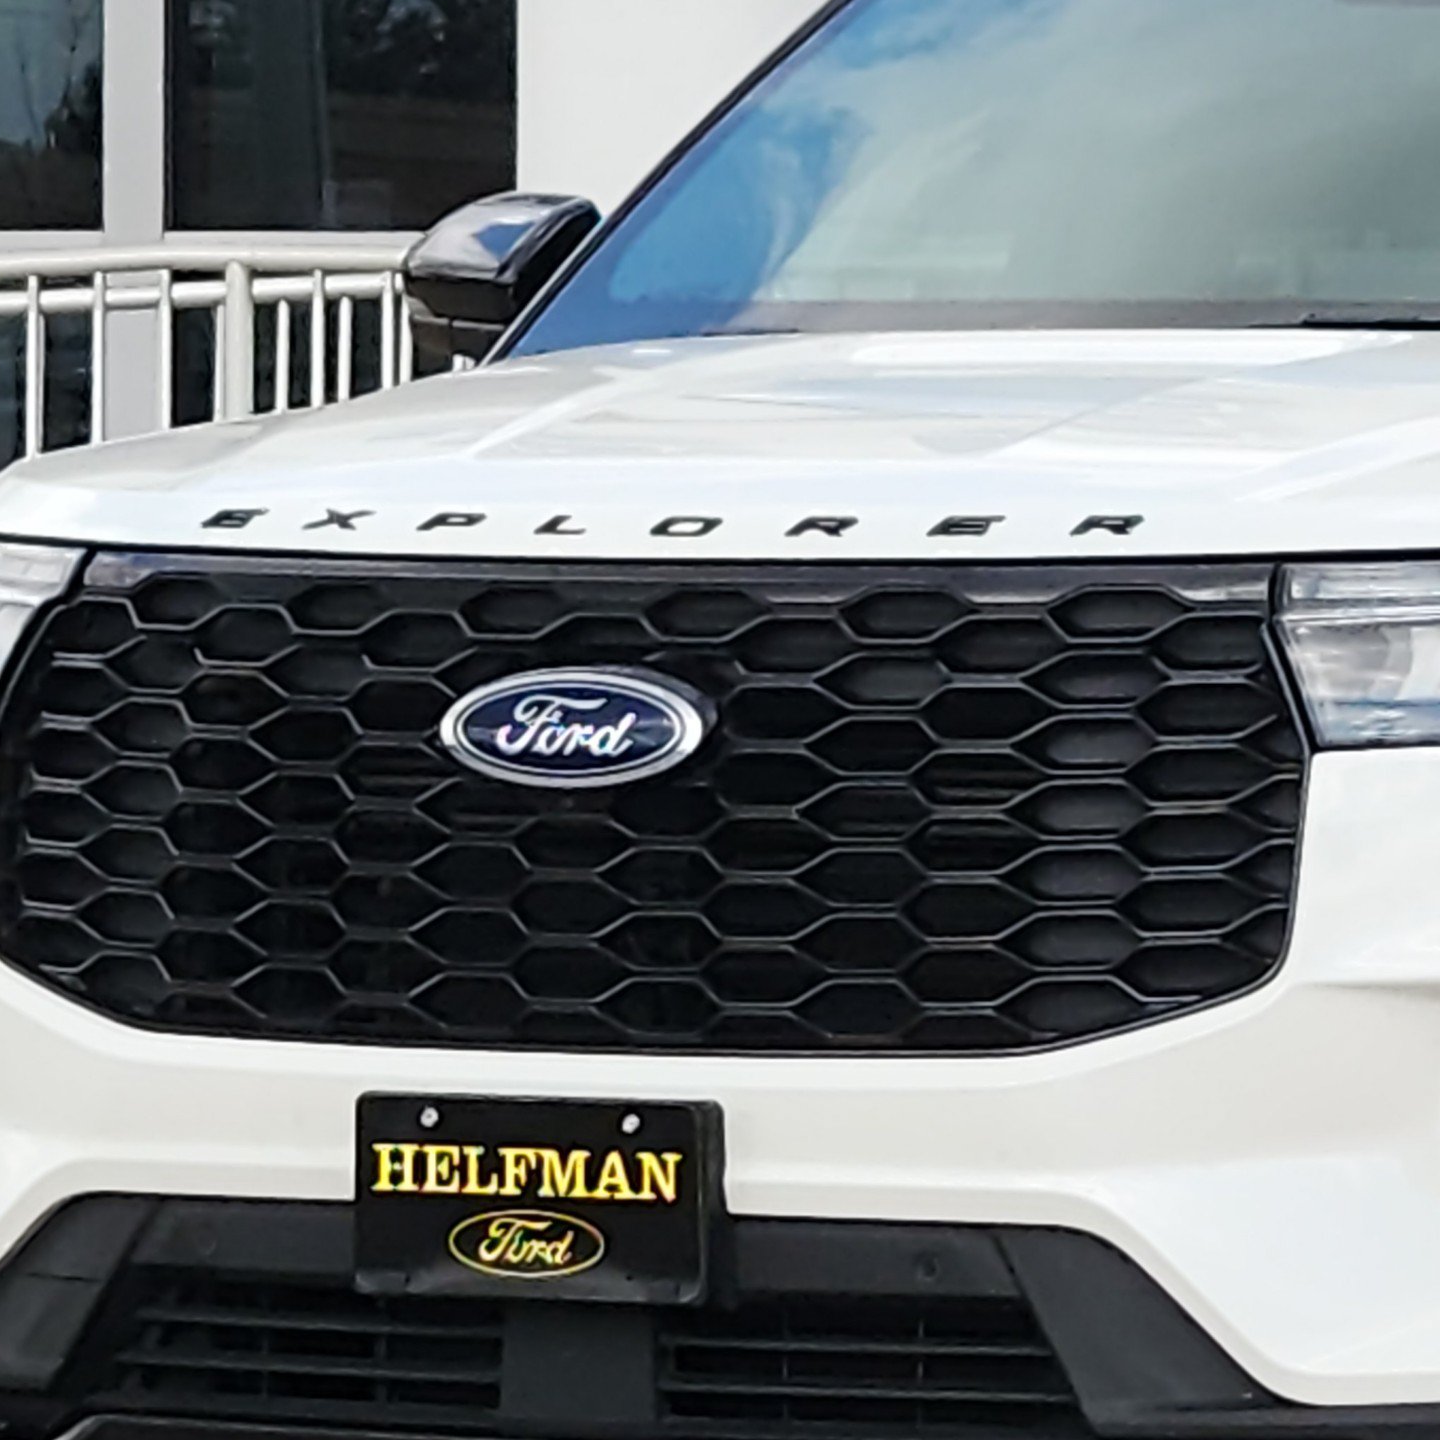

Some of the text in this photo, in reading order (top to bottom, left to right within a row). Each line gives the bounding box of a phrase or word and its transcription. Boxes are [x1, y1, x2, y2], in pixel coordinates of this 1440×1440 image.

[200, 507, 1147, 537] EXPLORER
[370, 1142, 683, 1203] HELFMAN
[477, 1216, 575, 1266] Ford
